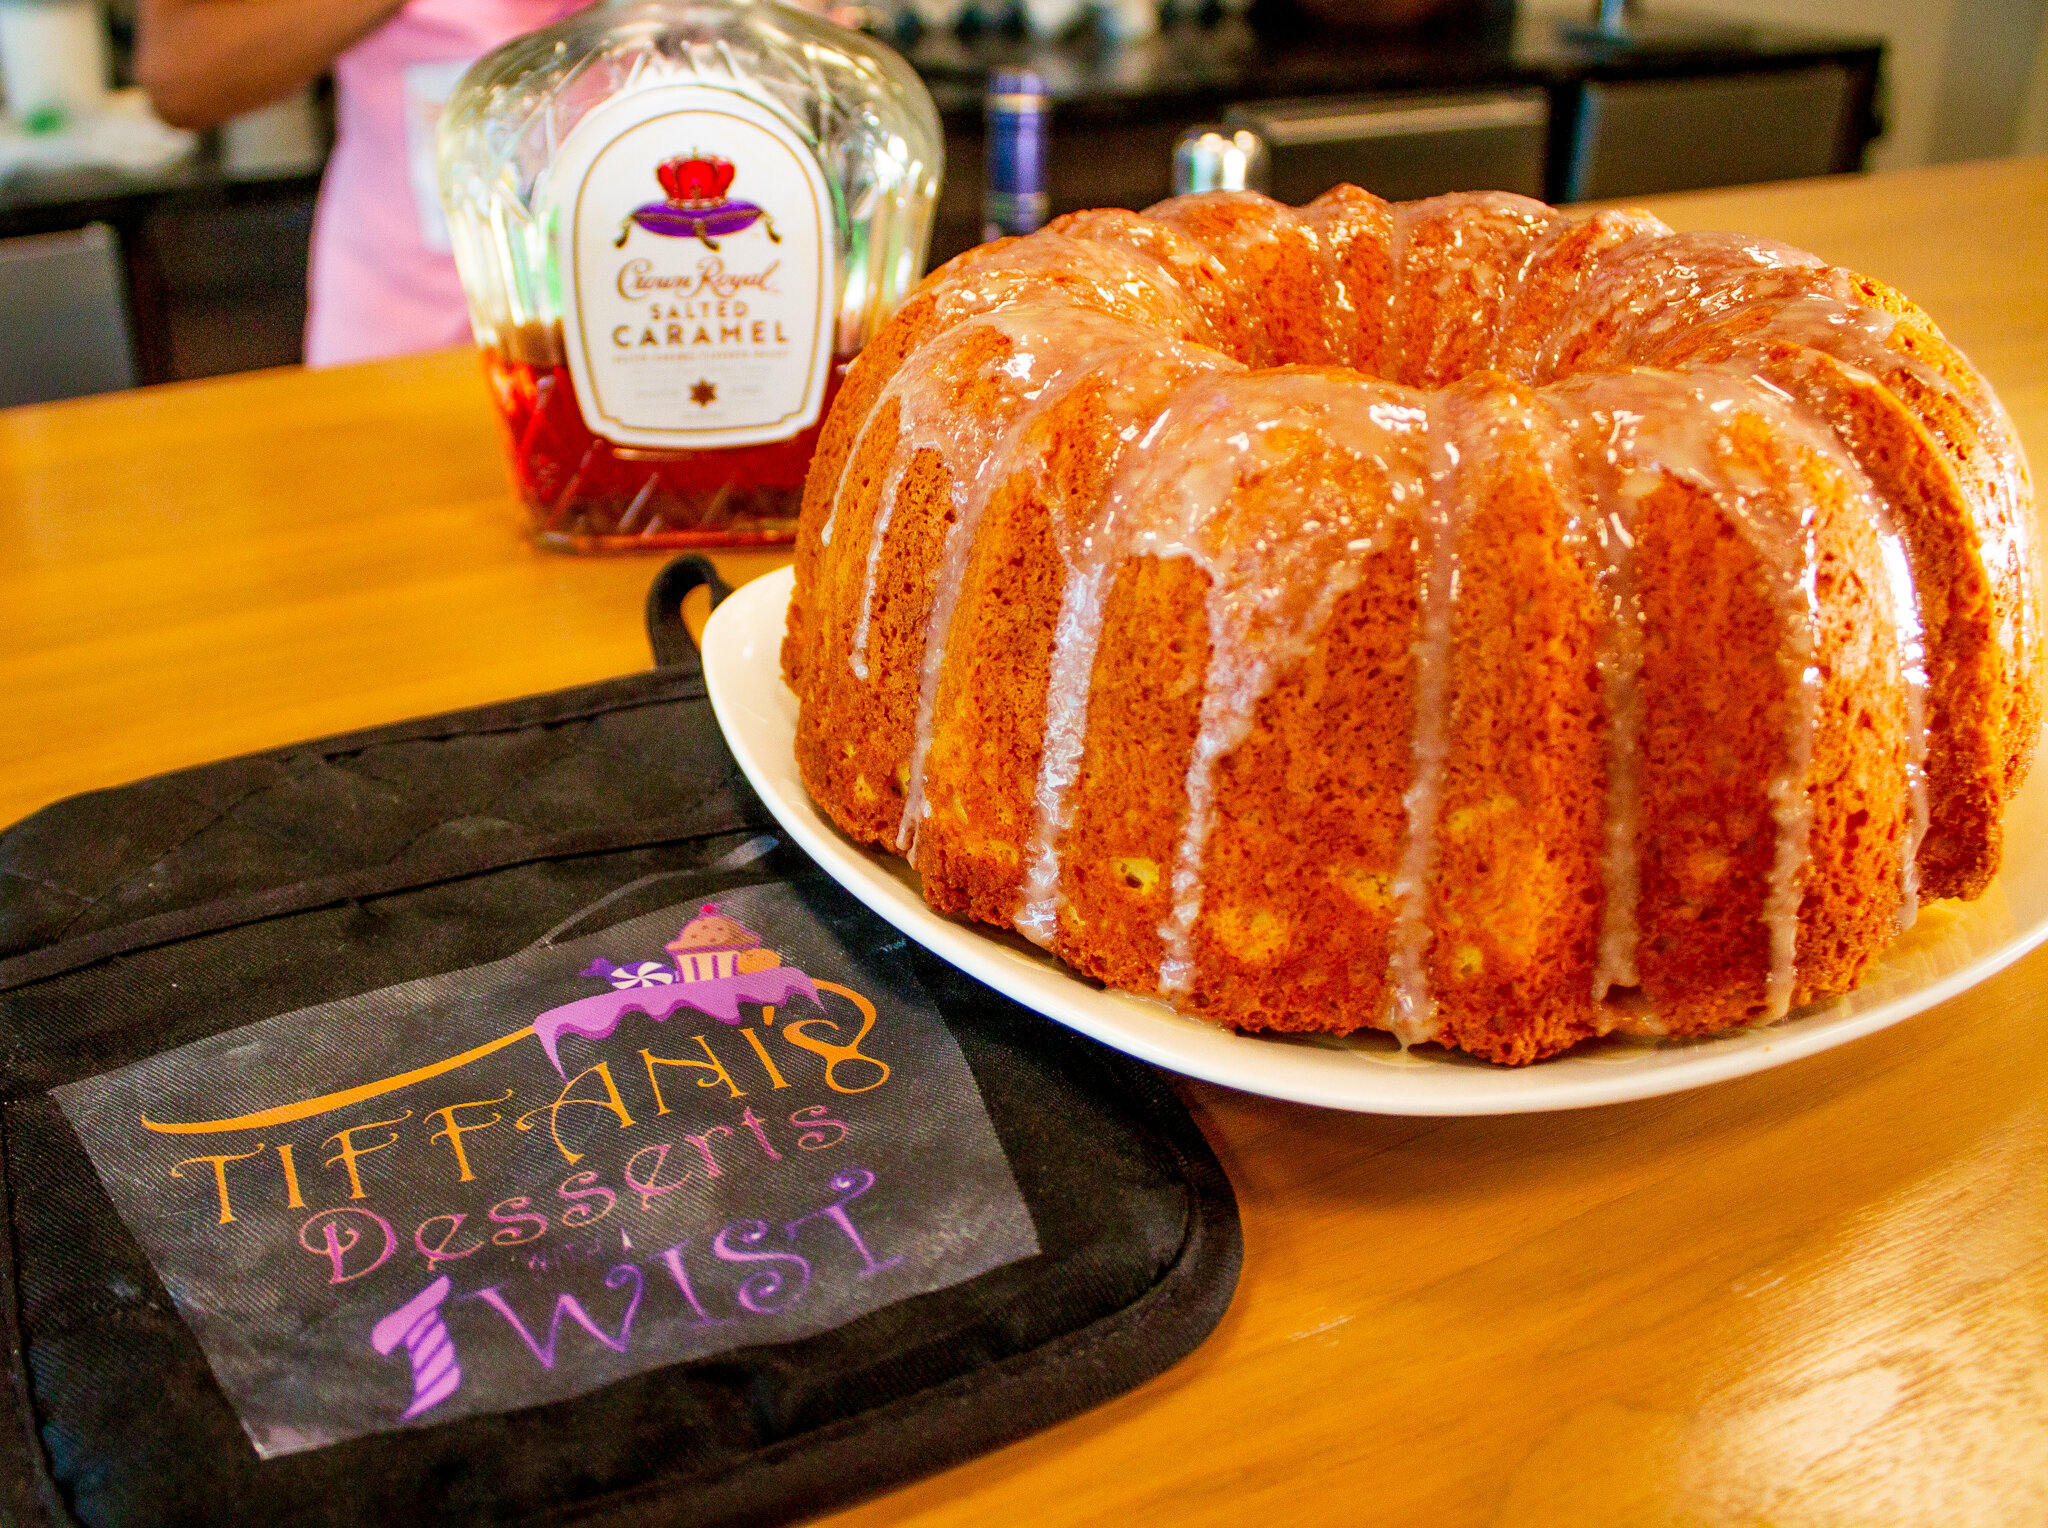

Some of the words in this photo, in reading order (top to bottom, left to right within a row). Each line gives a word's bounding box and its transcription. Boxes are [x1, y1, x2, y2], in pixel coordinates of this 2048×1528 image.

[612, 320, 789, 348] CARAMEL
[617, 257, 692, 301] Crown
[675, 254, 783, 300] Royal
[651, 300, 748, 320] SALTED
[170, 978, 890, 1225] TIFFANI'S
[300, 1105, 849, 1284] Desserts
[370, 1167, 904, 1420] TWIST
